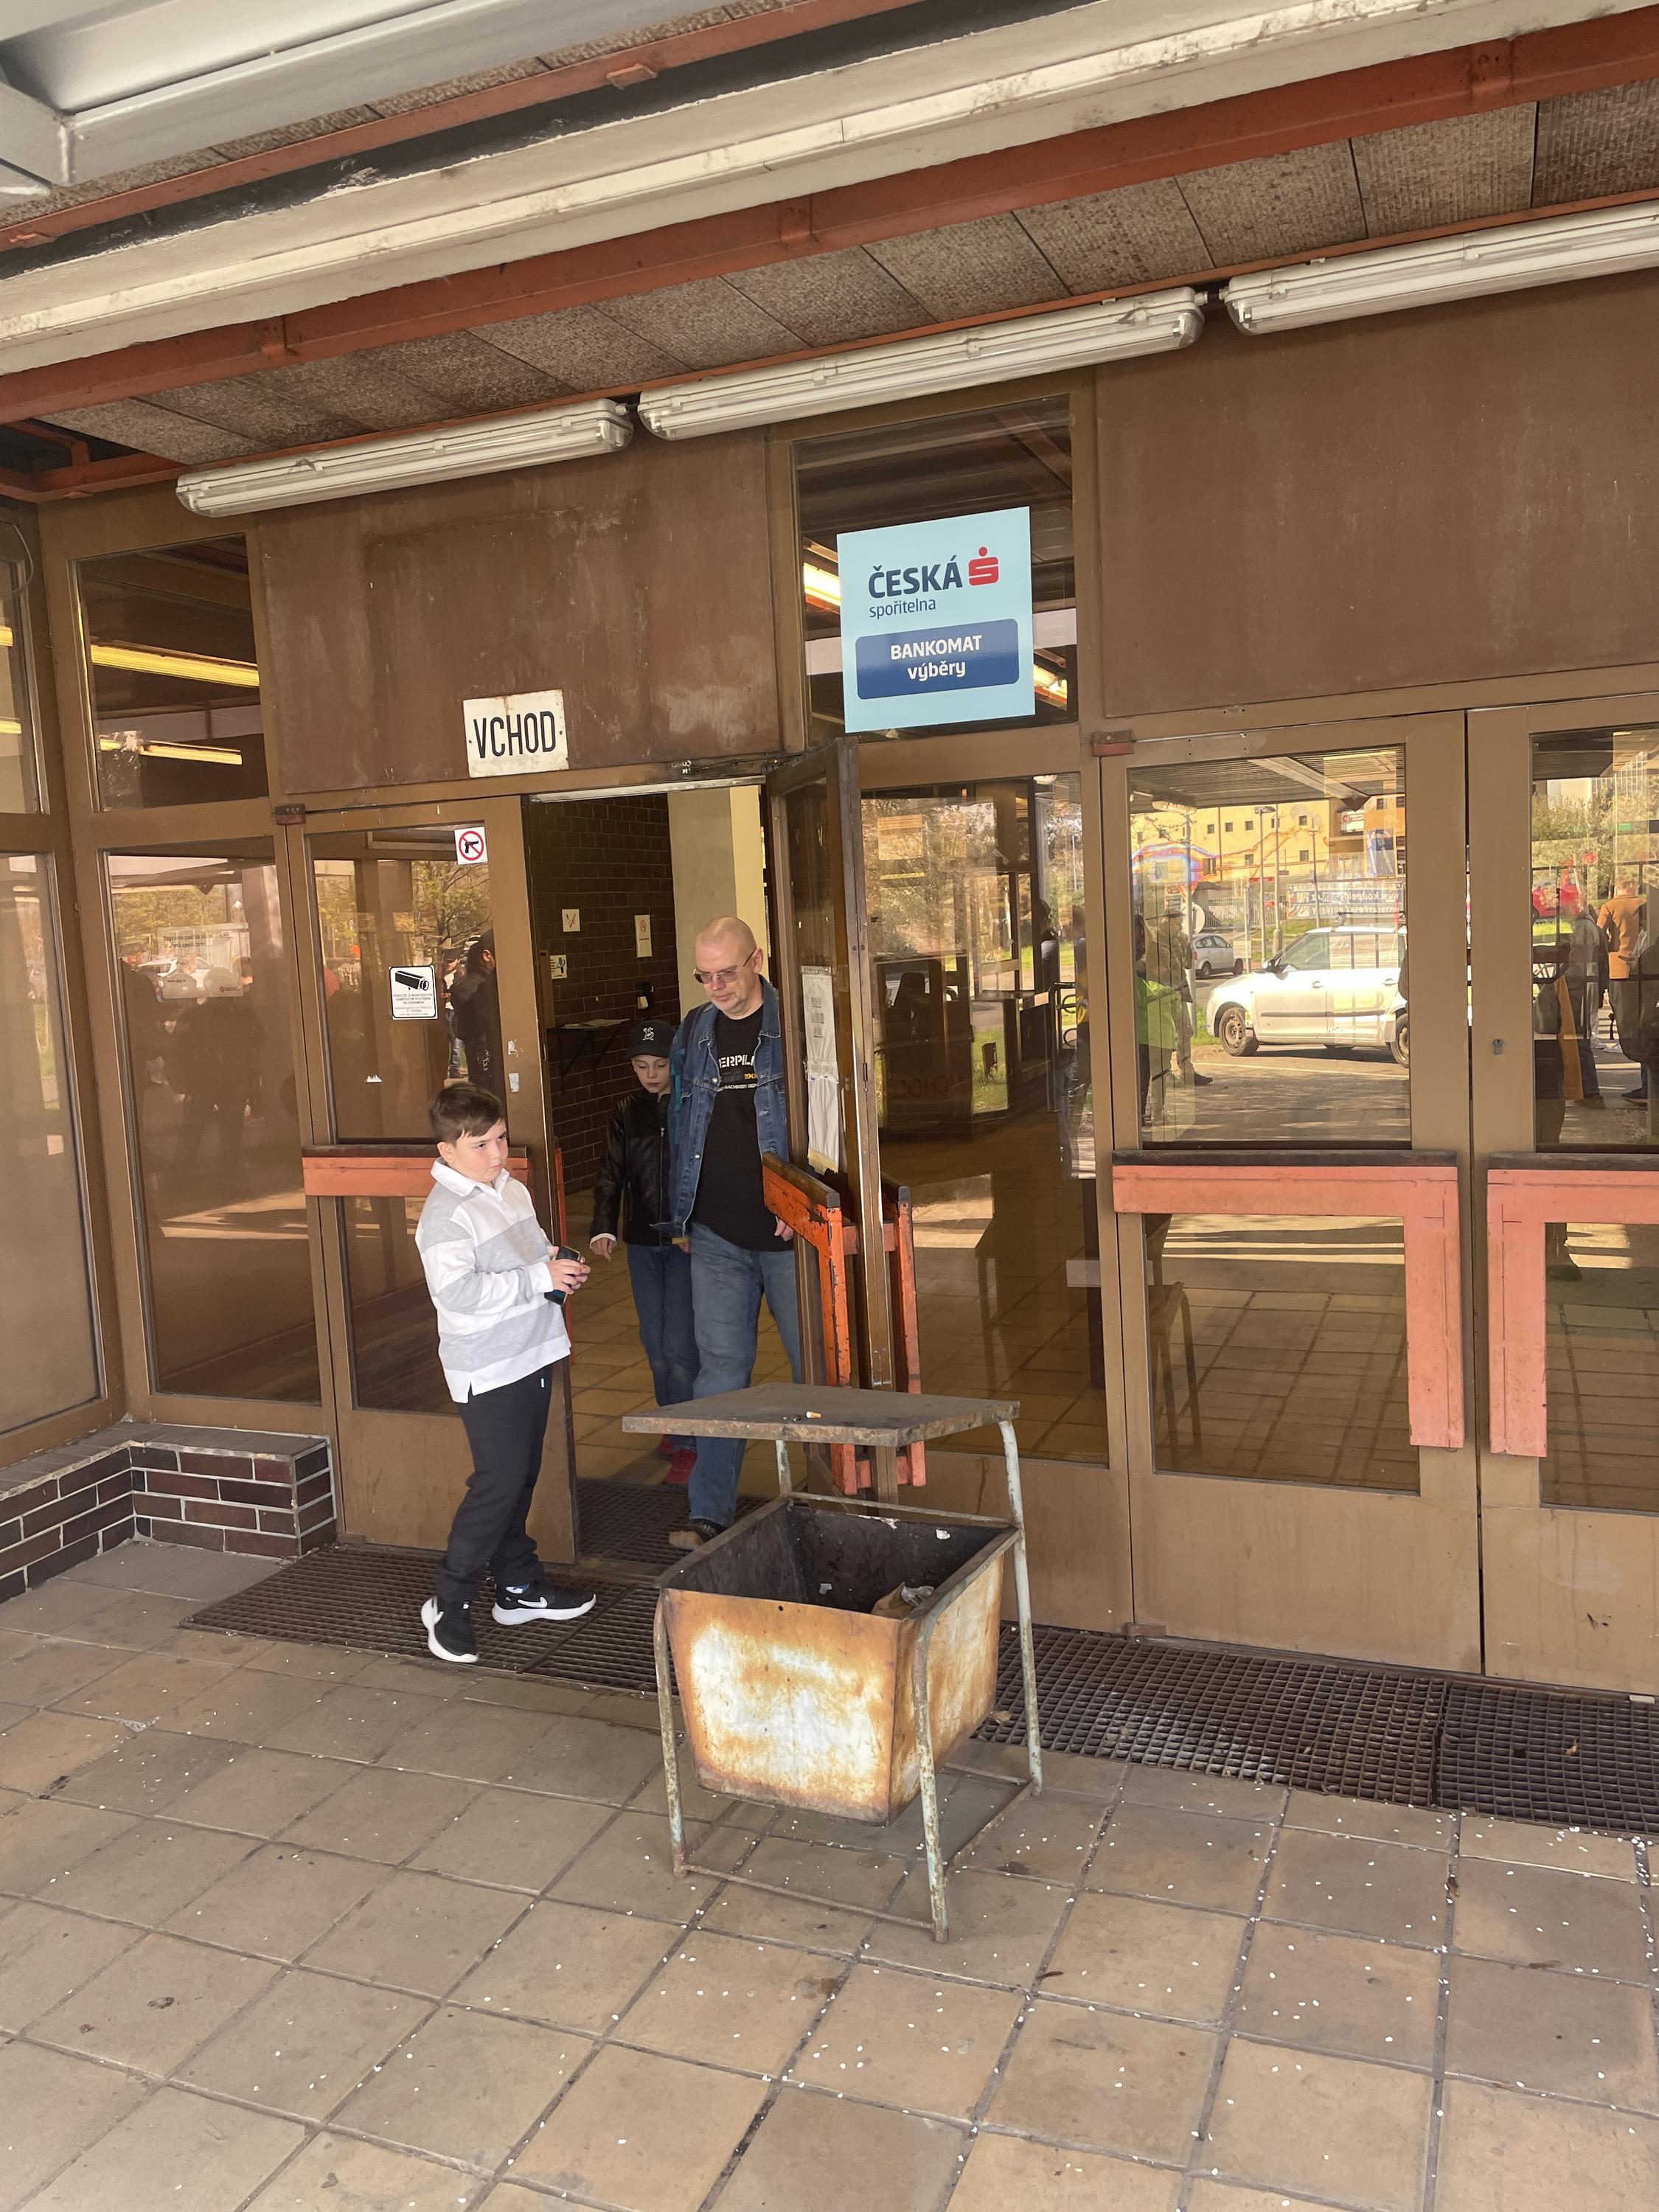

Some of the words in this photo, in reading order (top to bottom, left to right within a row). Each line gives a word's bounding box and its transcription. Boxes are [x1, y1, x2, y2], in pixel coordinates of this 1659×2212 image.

[868, 554, 963, 599] ČESKÁ
[869, 598, 936, 619] spořitelna
[890, 635, 982, 661] BANKOMAT
[907, 660, 966, 681] výběry
[473, 711, 556, 759] VCHOD
